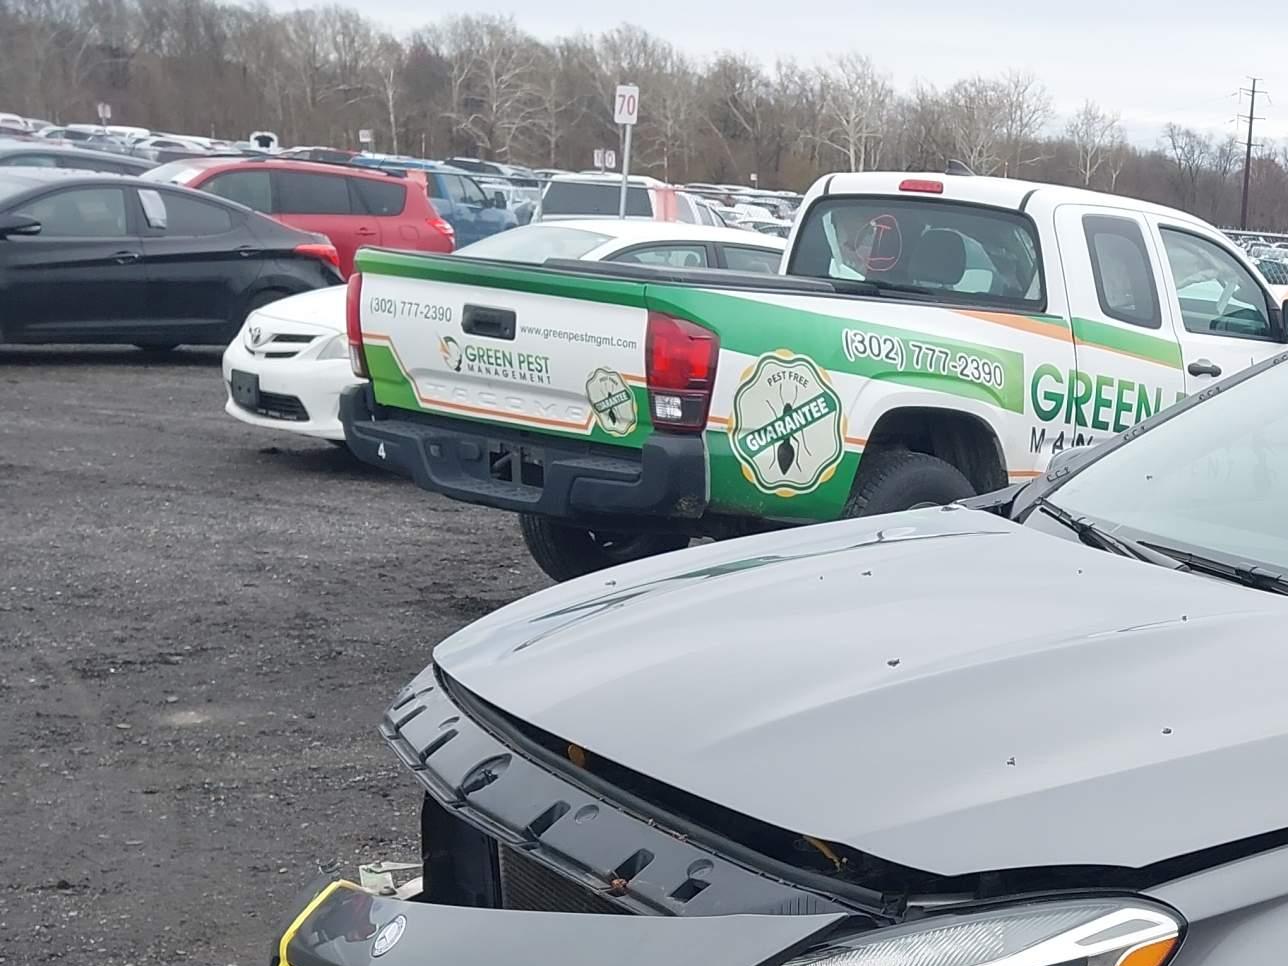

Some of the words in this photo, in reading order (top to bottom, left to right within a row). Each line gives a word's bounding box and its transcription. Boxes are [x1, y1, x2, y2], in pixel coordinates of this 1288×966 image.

[618, 94, 636, 115] 70
[369, 297, 397, 318] (302)
[400, 301, 452, 322] 777-2390
[519, 325, 637, 349] www.greenpestmgmt.com
[464, 344, 513, 369] GREEN
[518, 353, 549, 375] PEST
[842, 329, 906, 371] (302)
[909, 342, 1004, 388] 777-2390
[467, 363, 551, 384] MANAGEMENT
[766, 371, 786, 386] PEST
[788, 371, 809, 388] FREE
[1030, 363, 1163, 434] GREEN
[745, 396, 830, 452] GUARANTEE
[377, 440, 386, 460] 4
